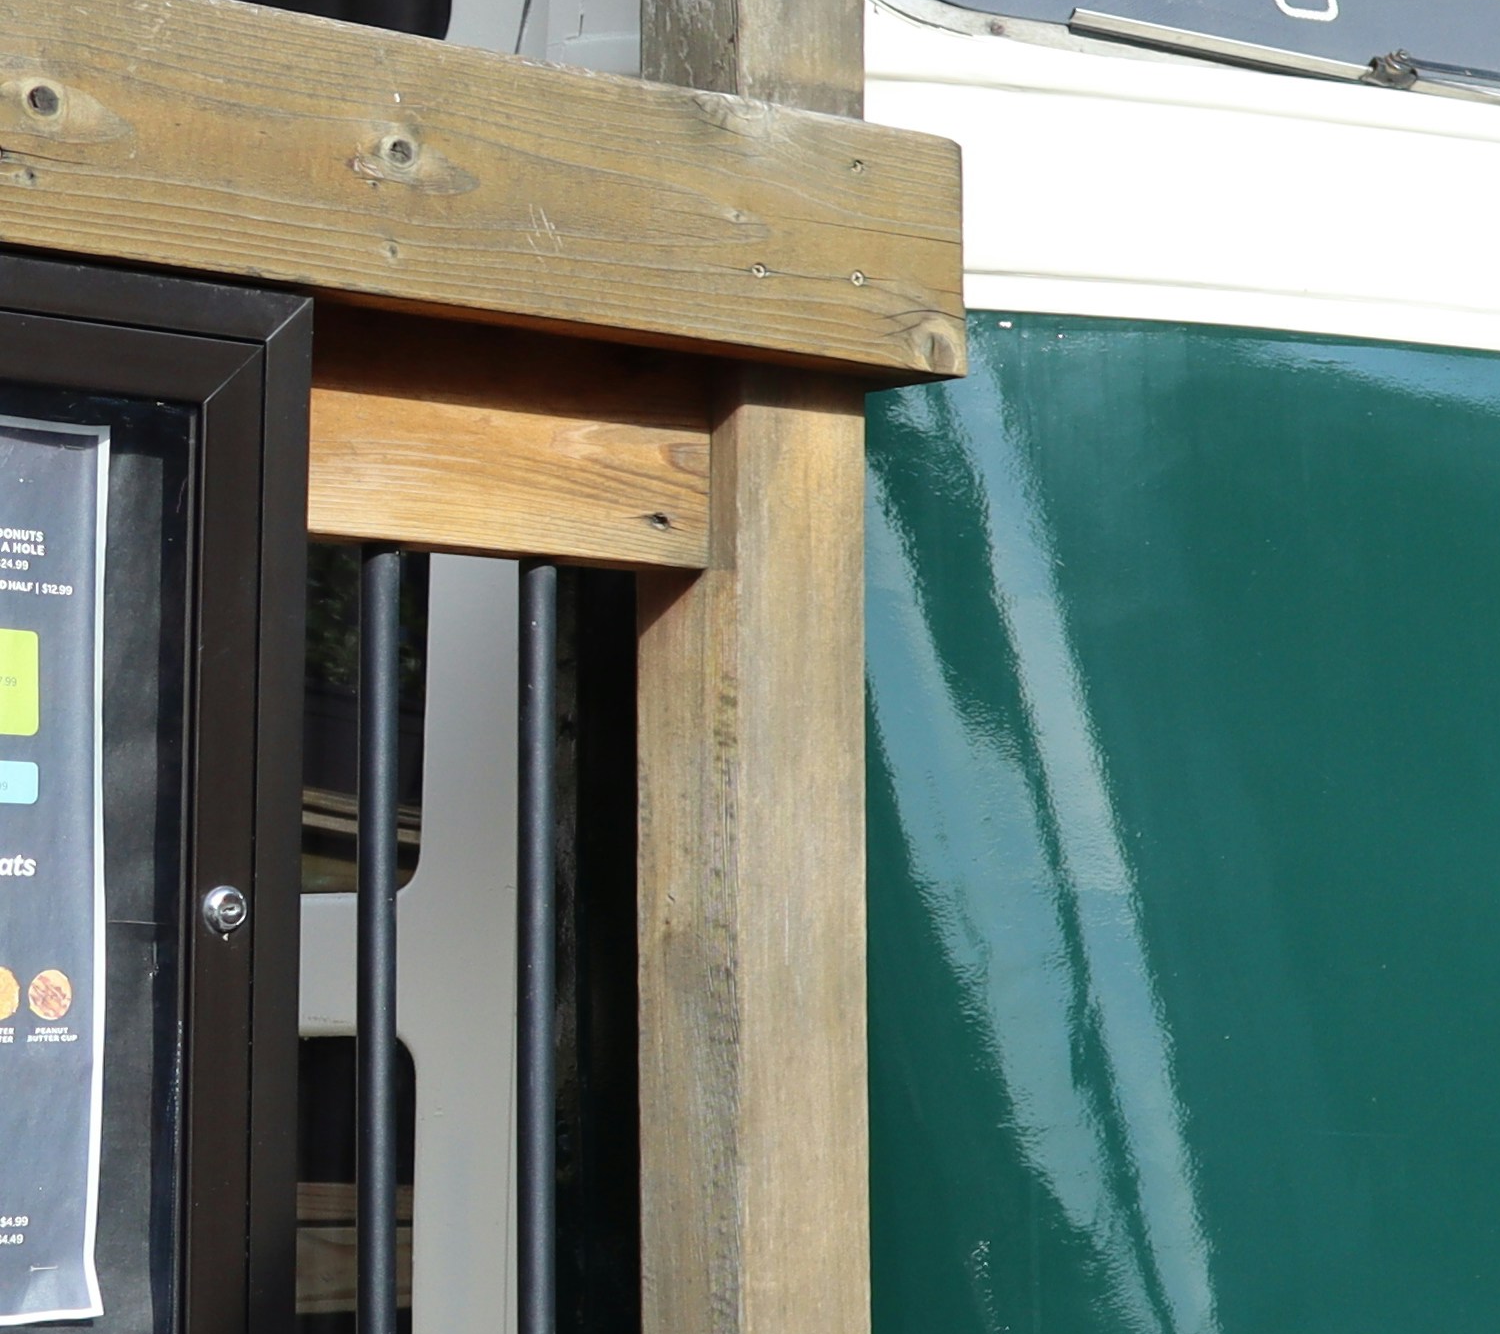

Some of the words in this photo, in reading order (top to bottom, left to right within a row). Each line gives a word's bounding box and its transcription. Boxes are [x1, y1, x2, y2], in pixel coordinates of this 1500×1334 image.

[1, 541, 11, 553] A
[12, 542, 45, 556] HOLE
[8, 580, 34, 592] HALF
[41, 582, 73, 596] $12.99
[35, 1027, 68, 1035] PEANUT
[27, 1034, 59, 1043] BUTTER
[60, 1034, 78, 1042] CUP
